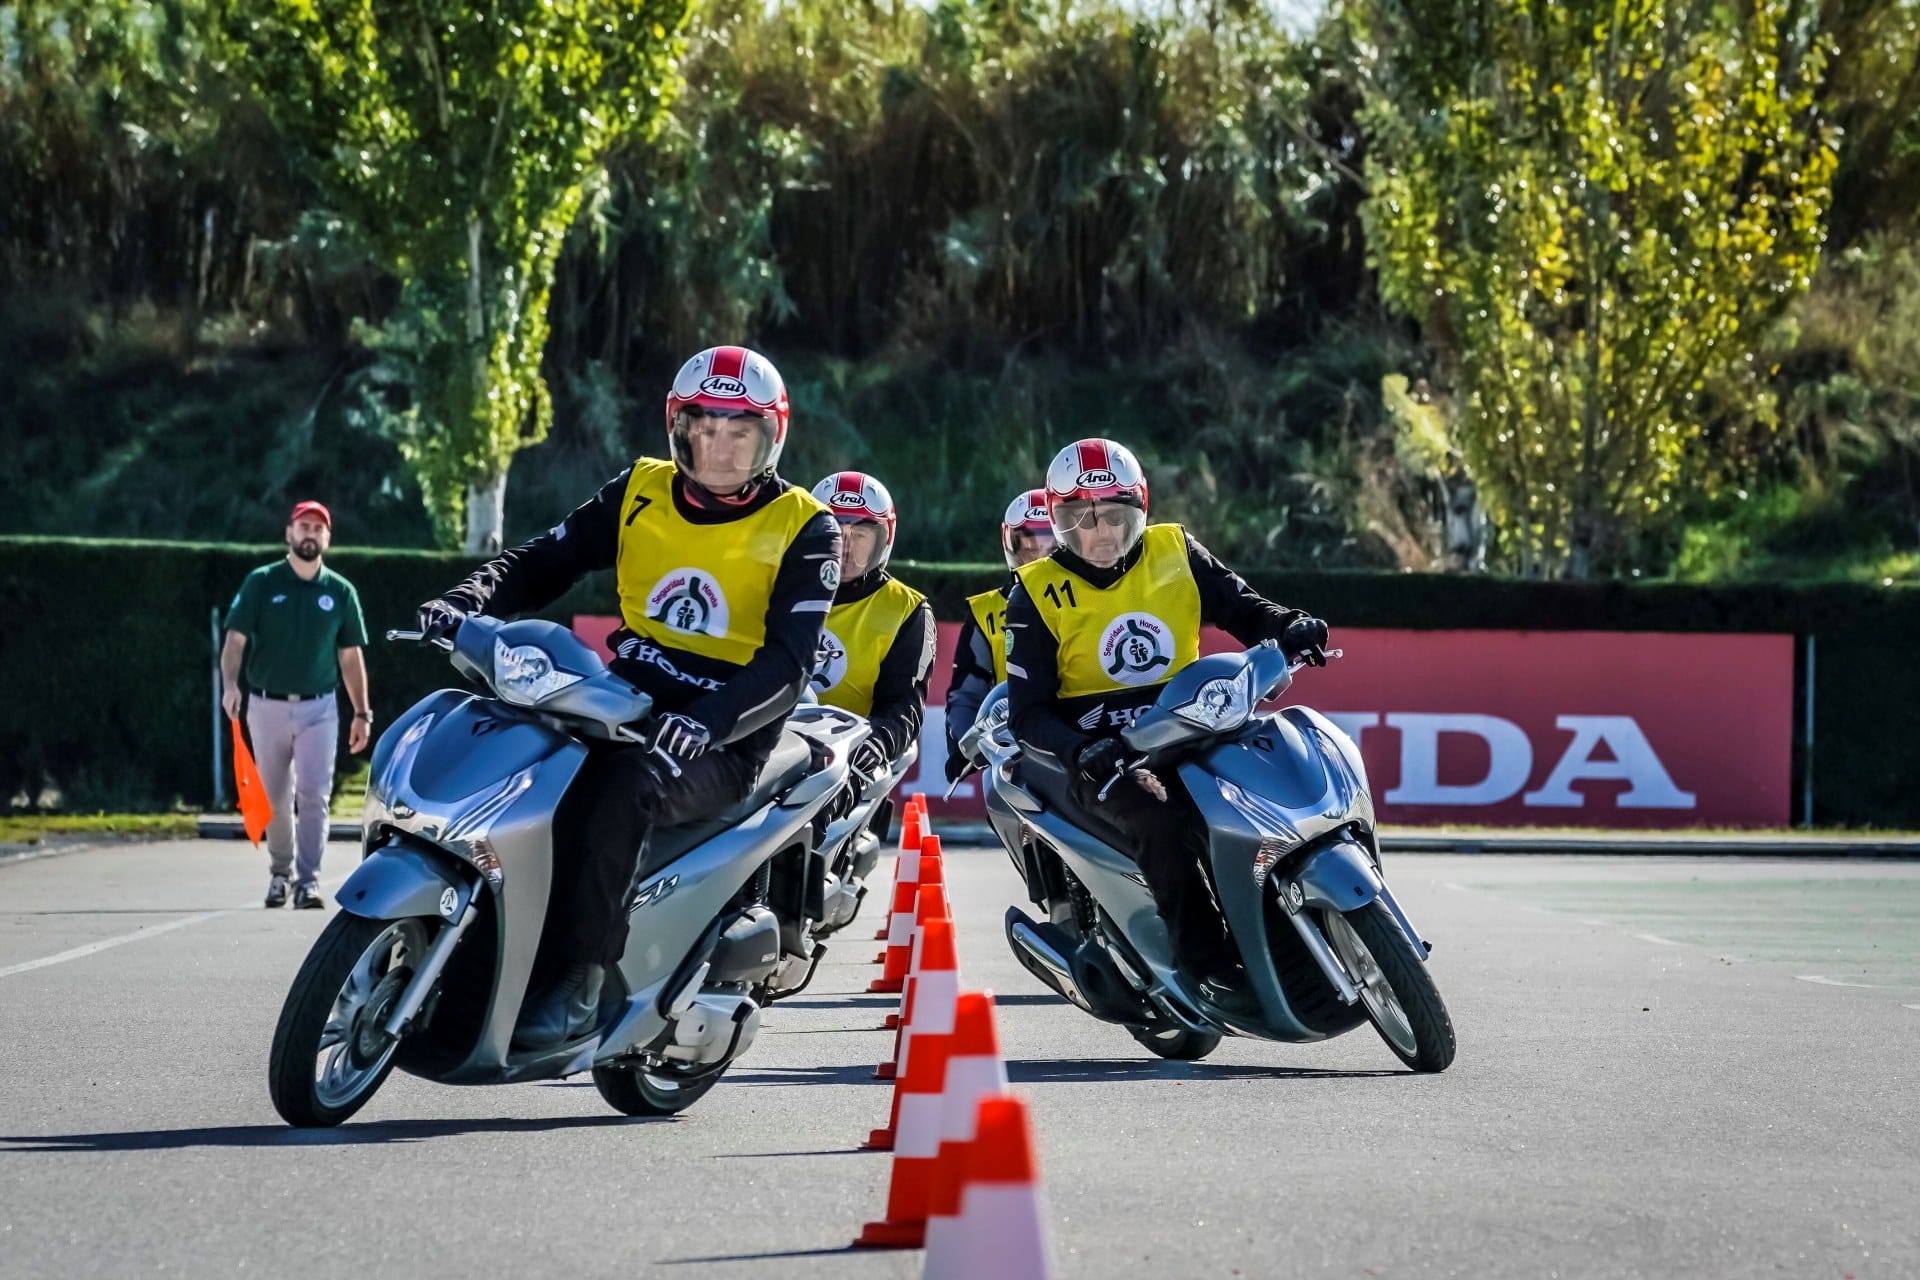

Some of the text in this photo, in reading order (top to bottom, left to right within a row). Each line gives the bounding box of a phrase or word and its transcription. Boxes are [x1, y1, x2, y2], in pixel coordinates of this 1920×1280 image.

[703, 377, 741, 393] Arai
[1079, 472, 1112, 485] Arai
[625, 495, 653, 527] 7
[1028, 507, 1049, 516] Ara
[1043, 579, 1077, 609] 11
[1103, 619, 1161, 657] Seguridad Honda
